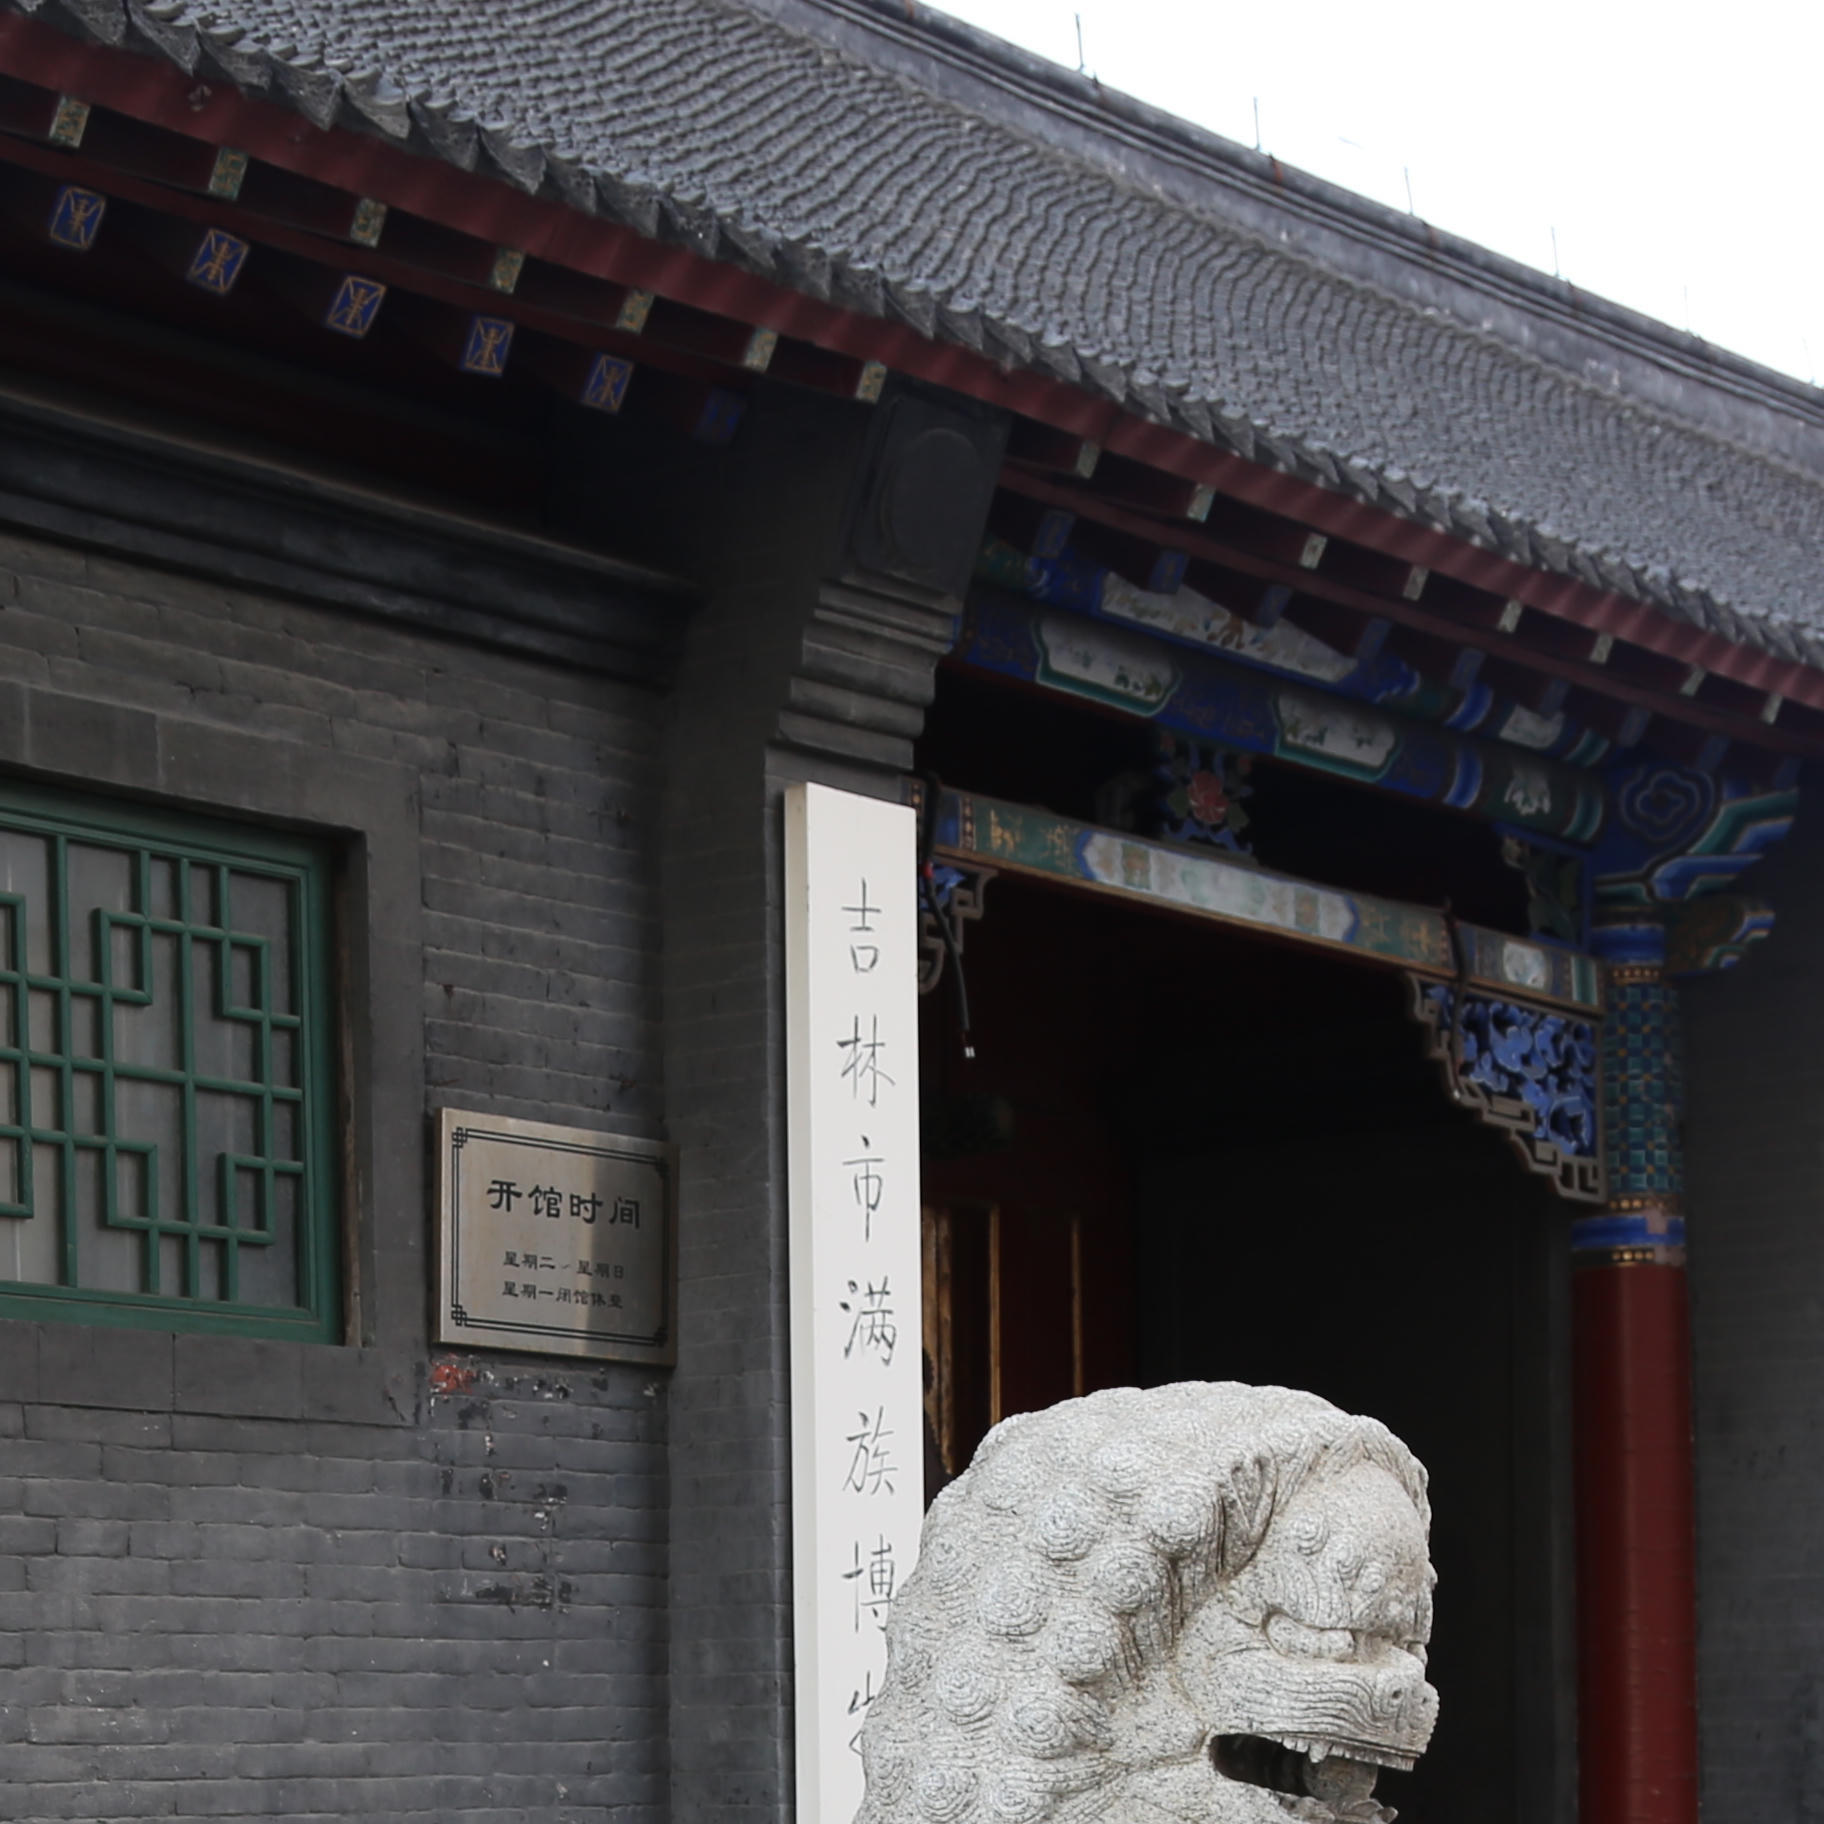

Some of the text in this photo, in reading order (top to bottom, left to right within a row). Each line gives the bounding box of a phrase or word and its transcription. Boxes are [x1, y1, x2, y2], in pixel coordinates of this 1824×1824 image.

[487, 1180, 641, 1229] 开馆时间
[837, 877, 898, 1757] 吉林市满族博
